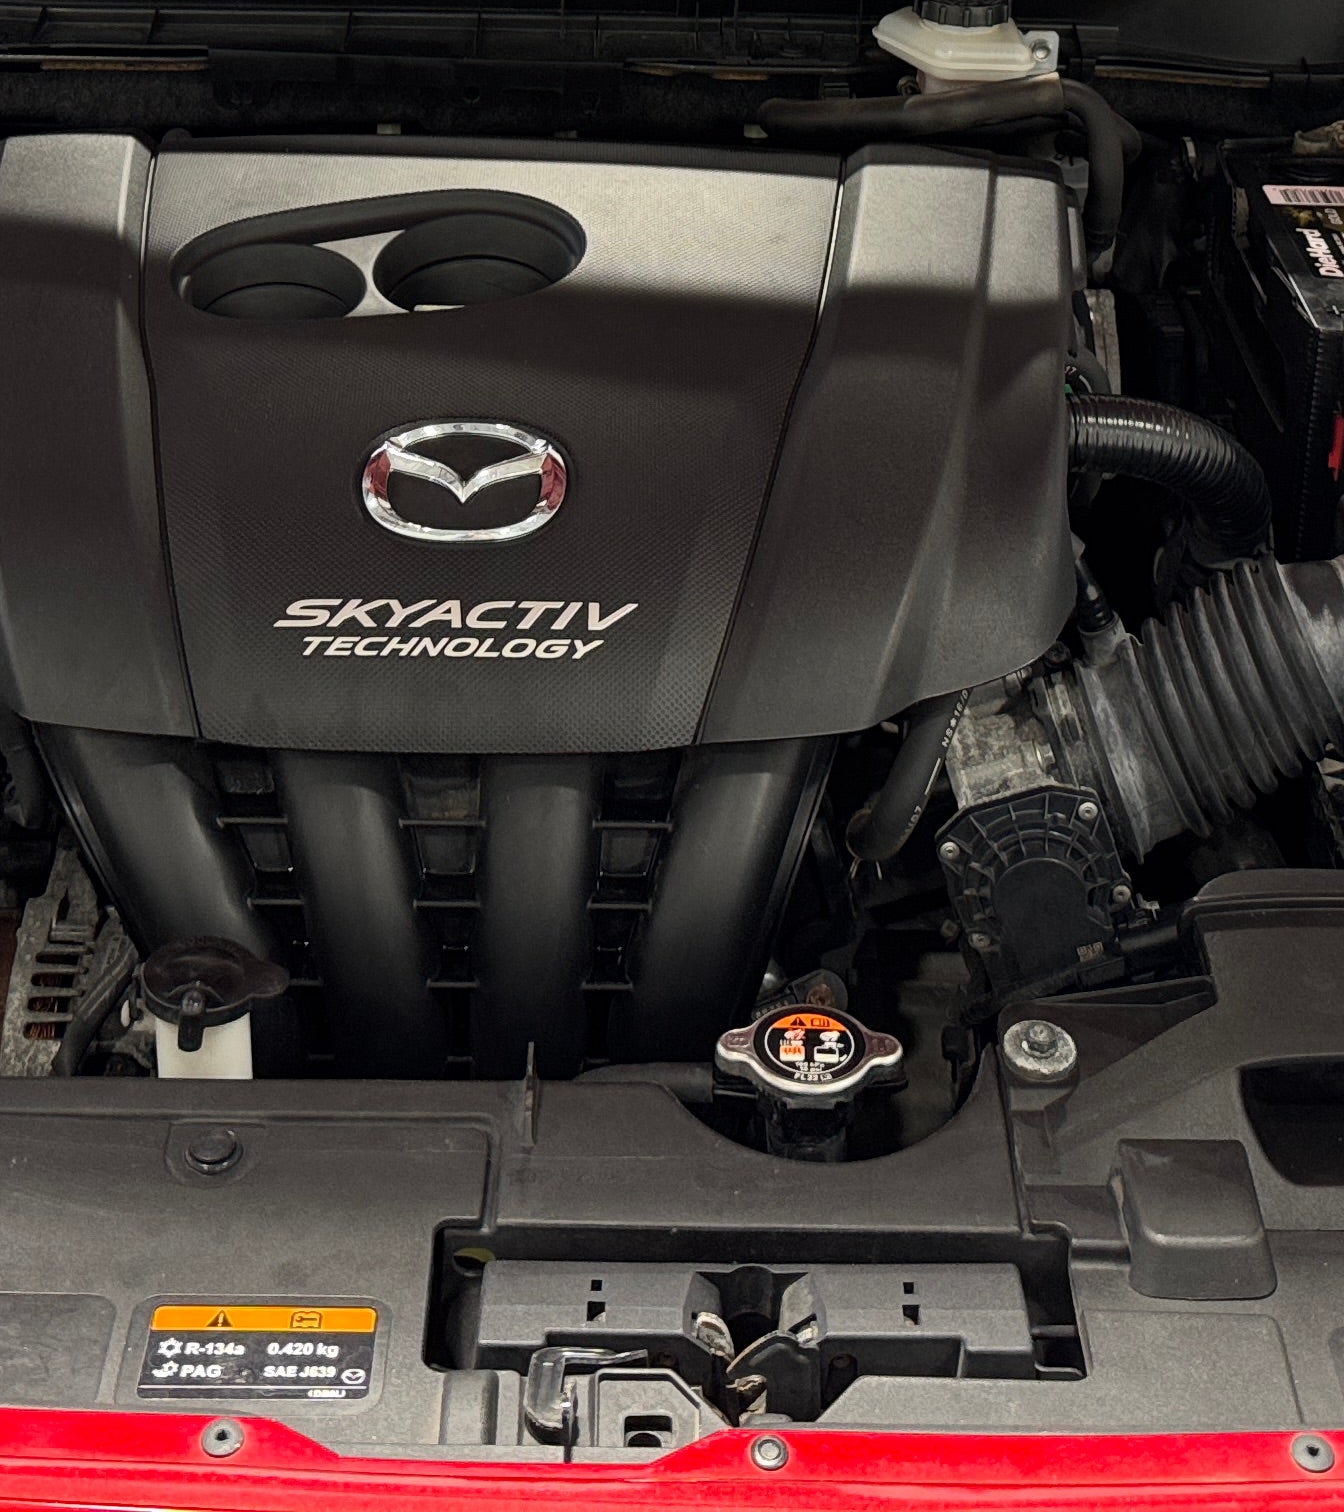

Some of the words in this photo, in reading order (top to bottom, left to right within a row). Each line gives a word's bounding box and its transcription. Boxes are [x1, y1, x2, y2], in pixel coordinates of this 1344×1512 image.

[1296, 228, 1344, 277] DieHard
[273, 598, 639, 631] SKYACTIV
[302, 636, 605, 660] TECHNOLOGY
[185, 1341, 246, 1356] R-134a
[267, 1341, 314, 1356] 0.420
[316, 1342, 339, 1358] kg
[179, 1364, 222, 1377] PAG
[263, 1365, 295, 1378] SAE
[298, 1365, 336, 1378] J639
